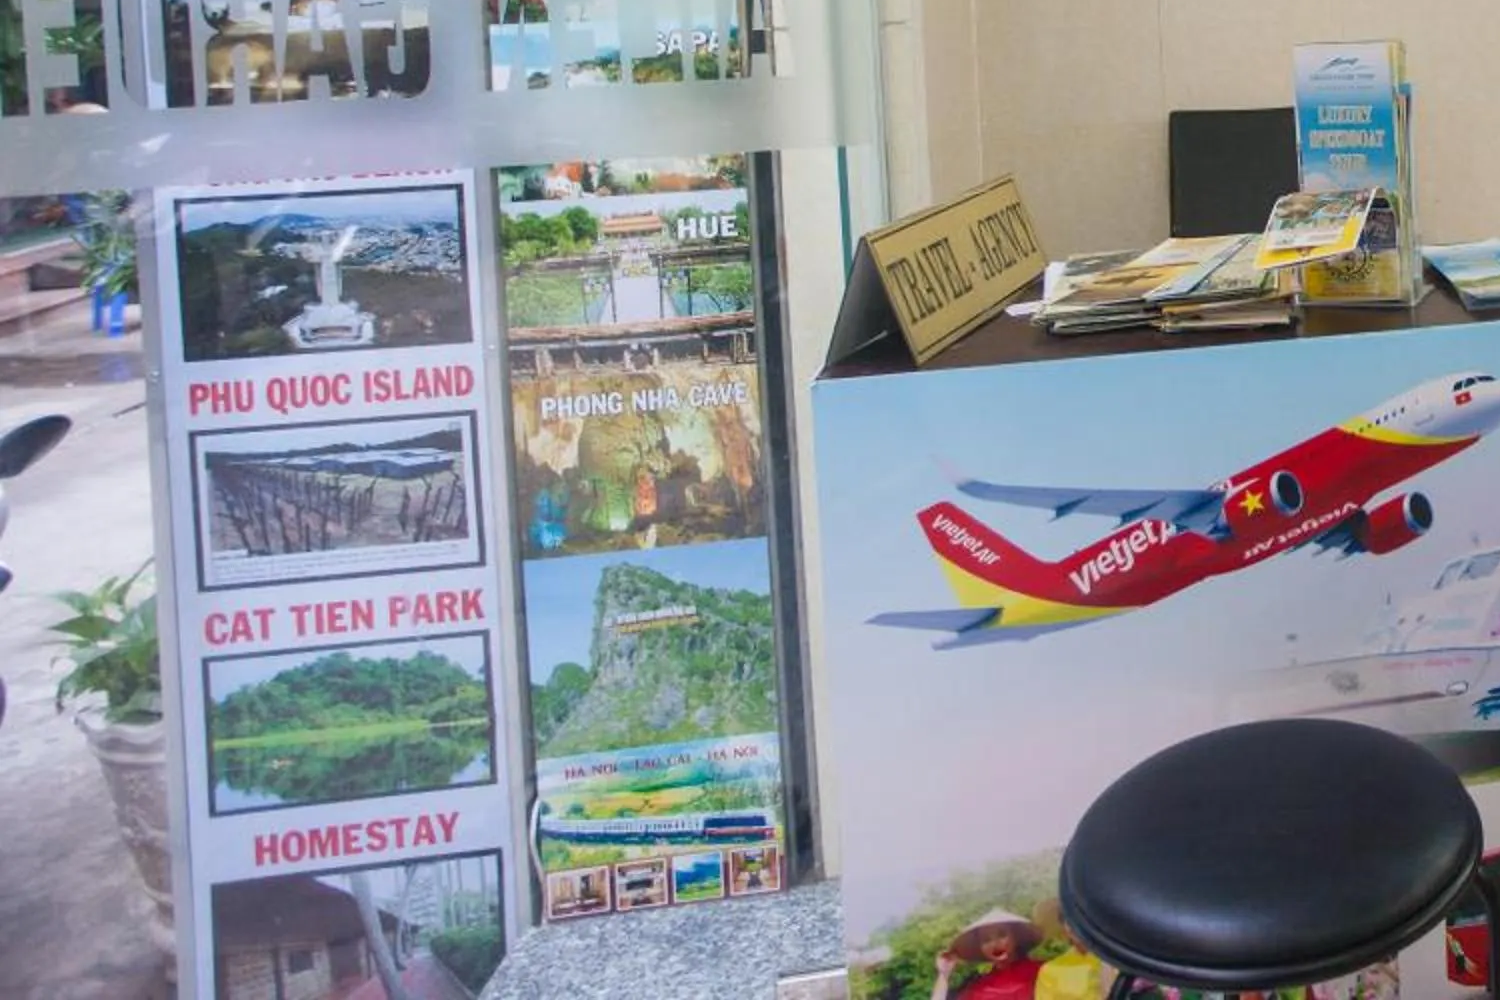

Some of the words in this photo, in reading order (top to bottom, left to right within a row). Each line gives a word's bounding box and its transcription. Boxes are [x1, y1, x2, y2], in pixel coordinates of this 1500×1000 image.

[676, 215, 738, 239] HUE
[886, 237, 973, 325] TRAVEL
[969, 202, 1038, 281] AGENCY
[189, 379, 255, 416] PHU
[266, 373, 352, 415] QUOC
[363, 365, 474, 403] ISLAND
[541, 391, 624, 419] PHONG
[631, 387, 681, 411] NHA
[688, 382, 748, 407] CAVE
[204, 607, 275, 646] CAT
[288, 599, 374, 637] TIEN
[388, 588, 485, 628] PARK
[254, 811, 460, 866] HOMESTAY
